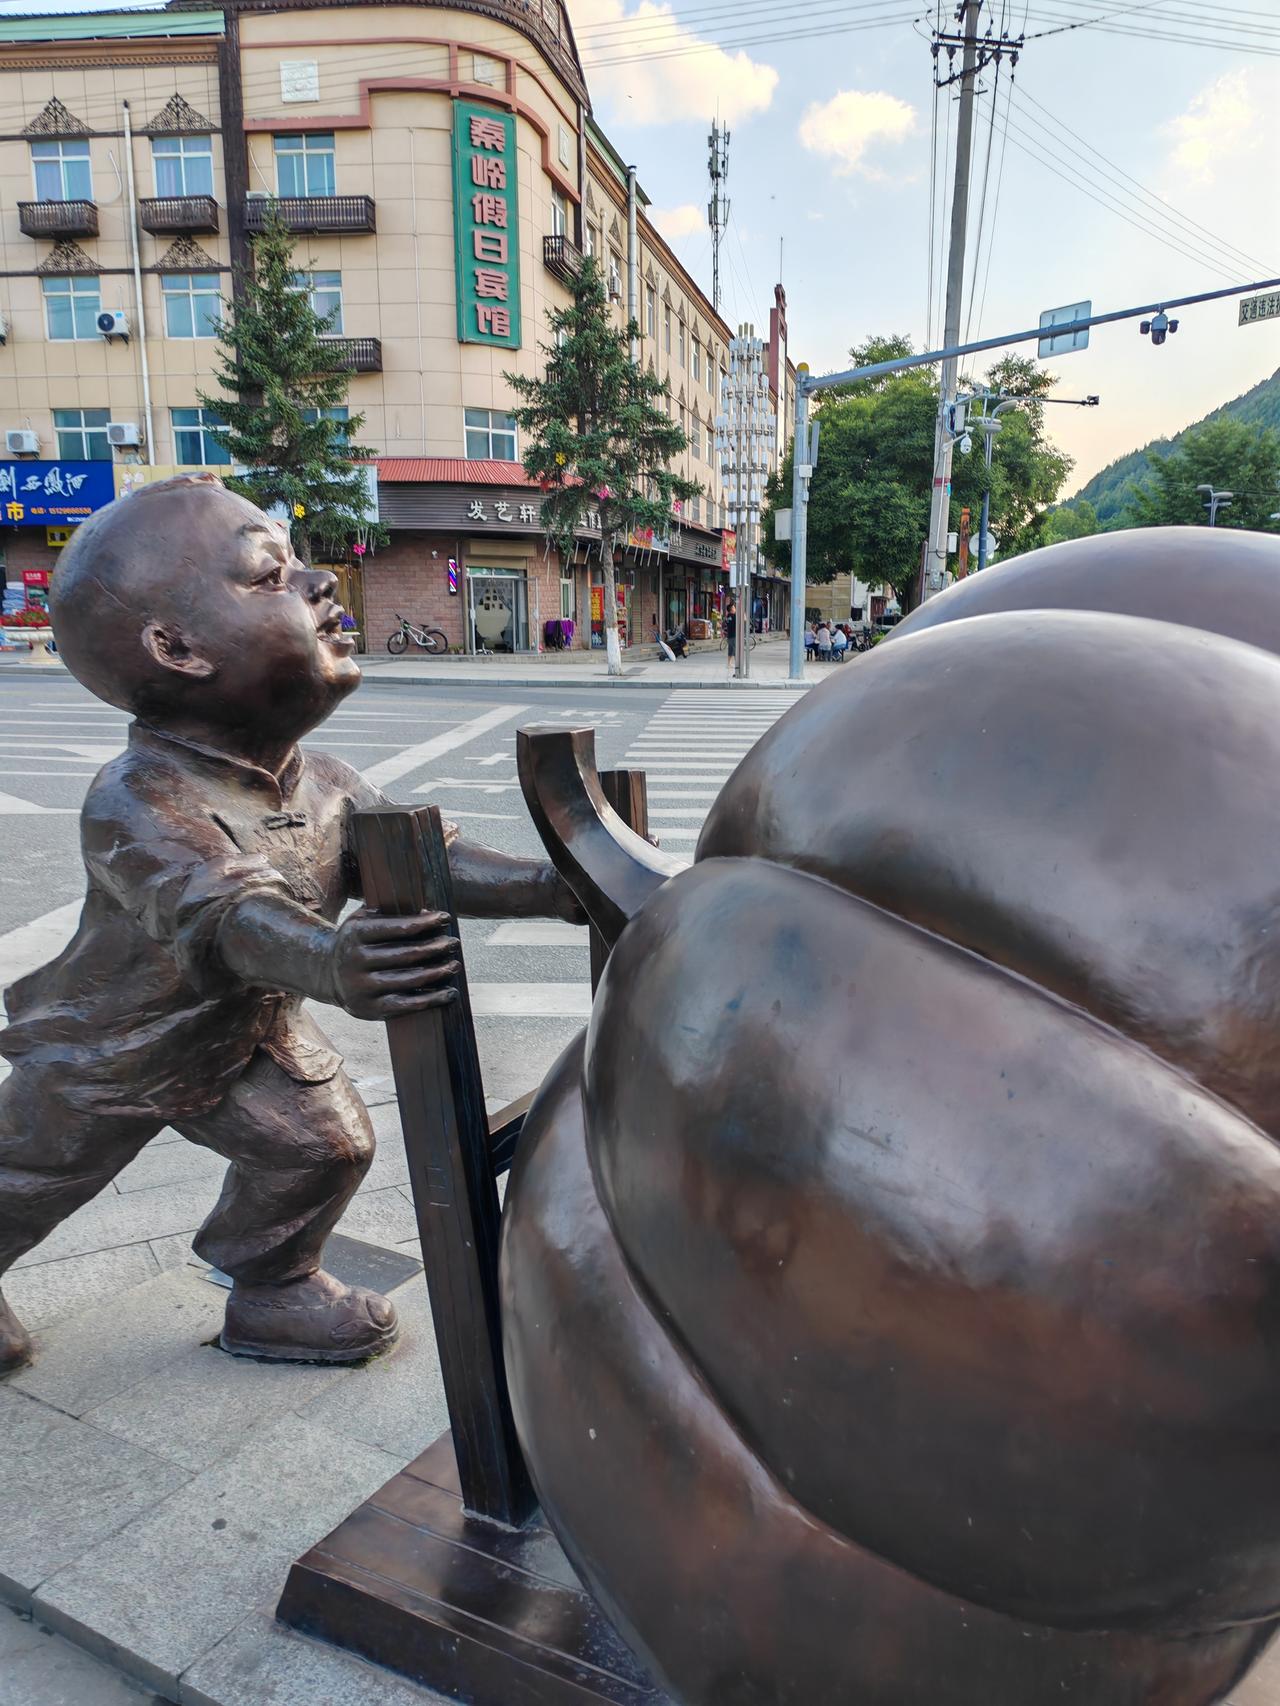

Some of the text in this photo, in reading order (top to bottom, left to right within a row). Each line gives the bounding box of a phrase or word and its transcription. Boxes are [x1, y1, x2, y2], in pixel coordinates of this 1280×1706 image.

[470, 115, 511, 338] 秦岭假日宾馆
[2, 502, 25, 521] 市
[468, 501, 536, 523] 发艺轩
